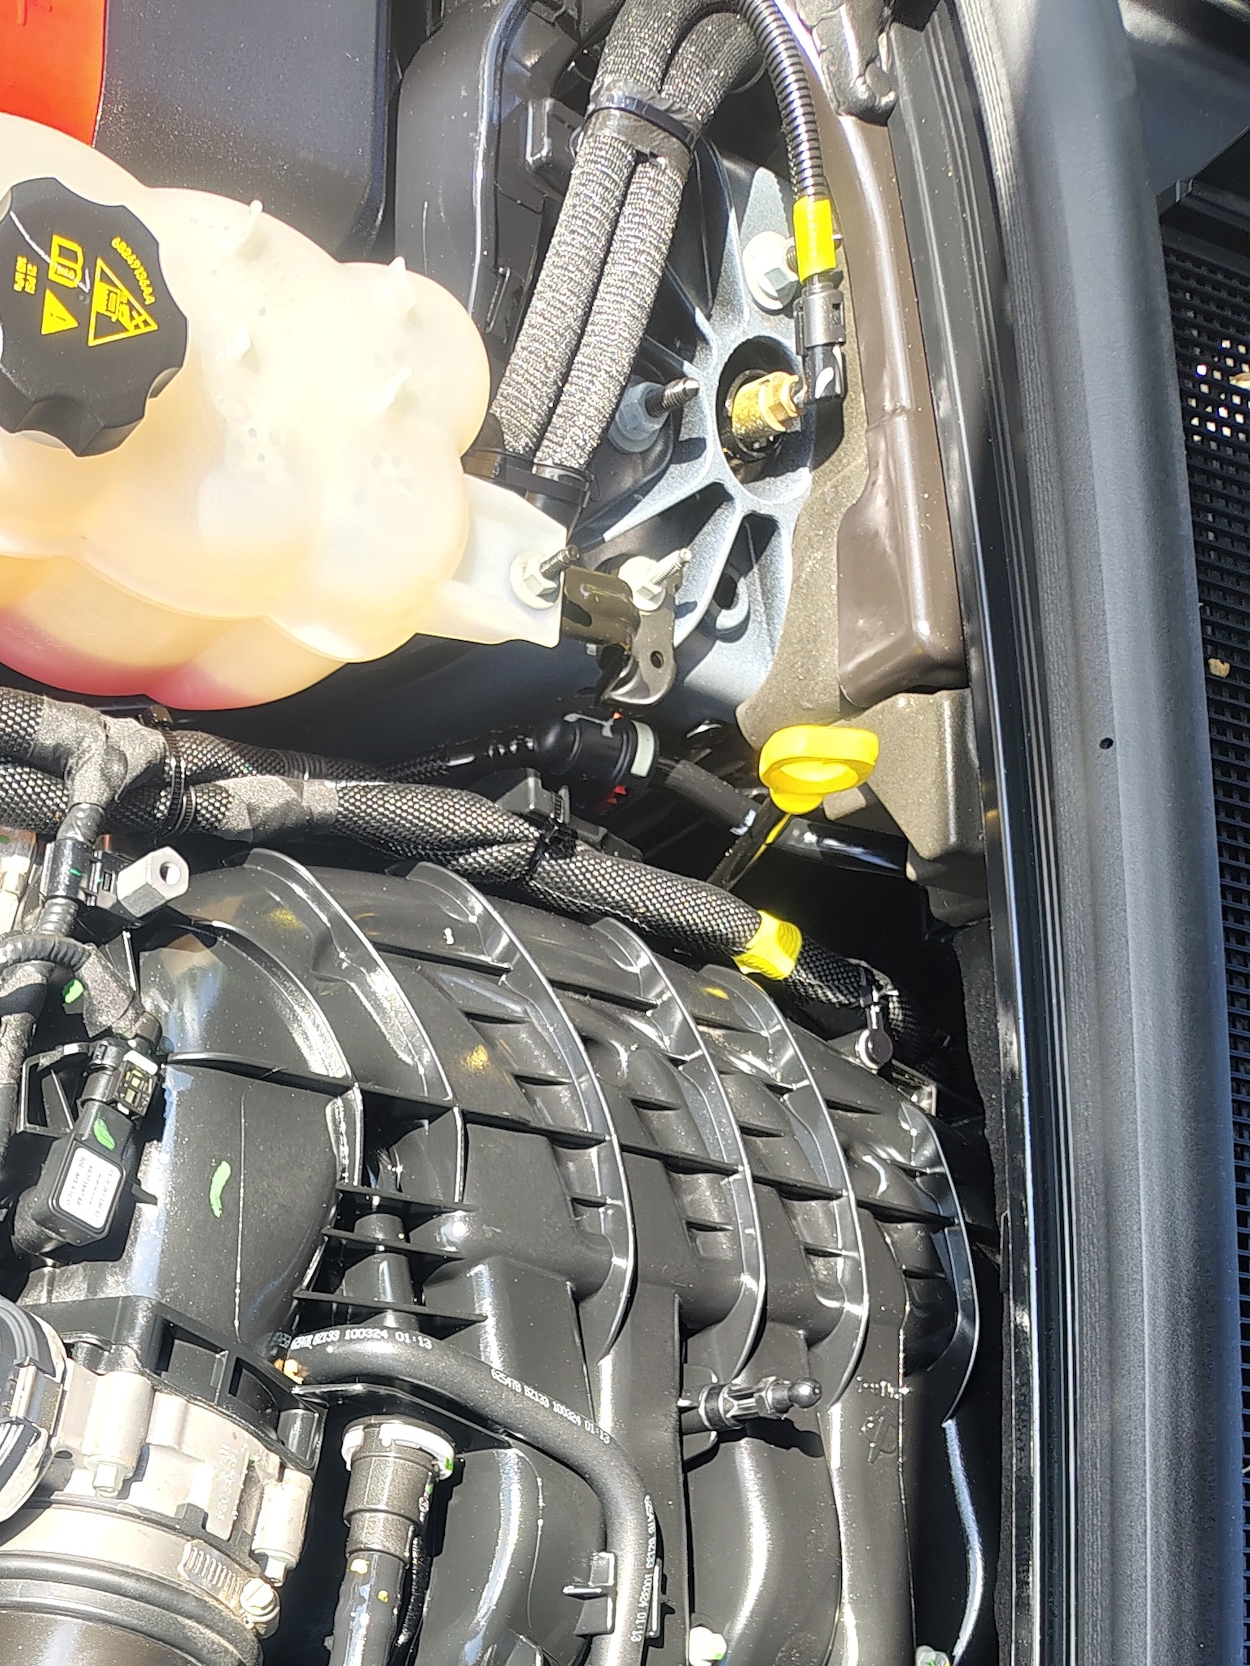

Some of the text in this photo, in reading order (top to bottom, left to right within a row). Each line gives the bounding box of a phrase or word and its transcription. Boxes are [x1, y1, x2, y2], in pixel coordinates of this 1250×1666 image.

[345, 1329, 389, 1340] 100324
[394, 1329, 433, 1350] 01:13
[585, 1420, 610, 1444] 01:13
[638, 1573, 653, 1608] 100324
[630, 1613, 647, 1642] 01:13
